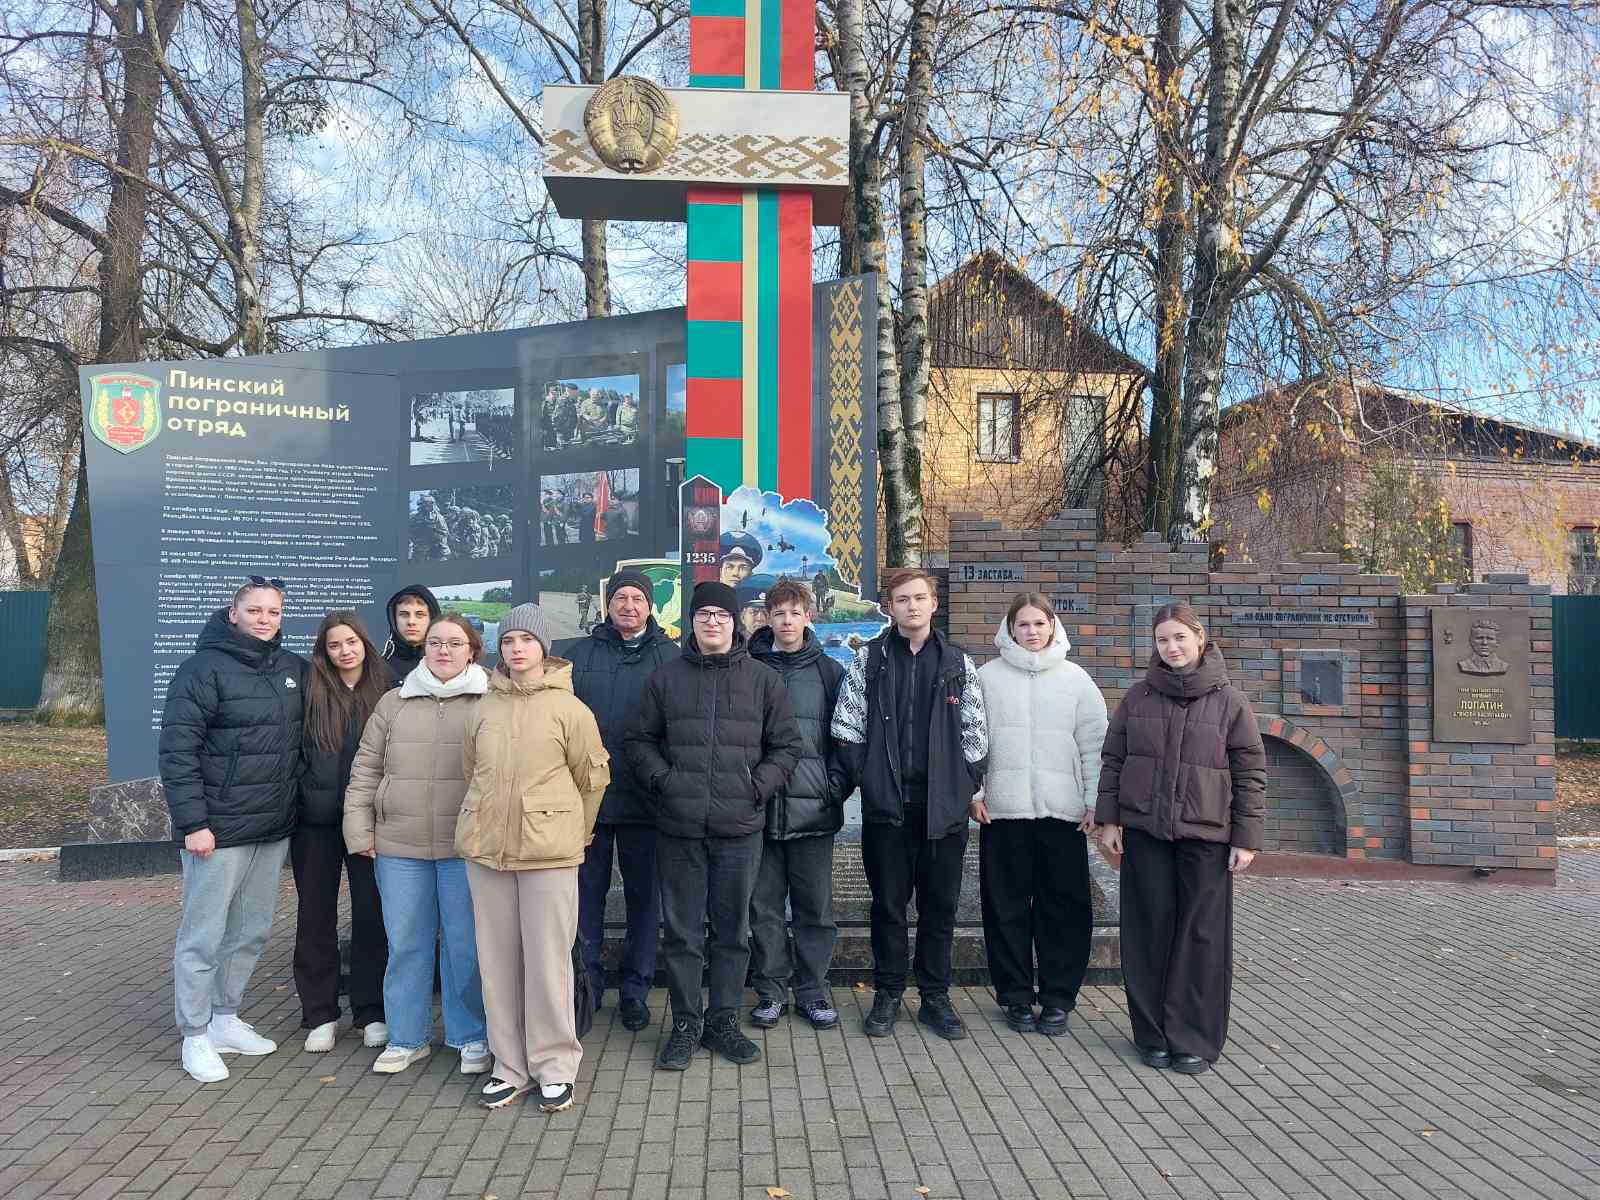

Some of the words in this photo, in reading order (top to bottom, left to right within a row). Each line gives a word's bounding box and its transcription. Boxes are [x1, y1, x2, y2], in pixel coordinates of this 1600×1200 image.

[169, 369, 285, 396] Пинский
[168, 395, 350, 422] пограничный
[167, 416, 247, 437] отряд
[686, 552, 716, 563] 1235
[963, 565, 974, 580] 13
